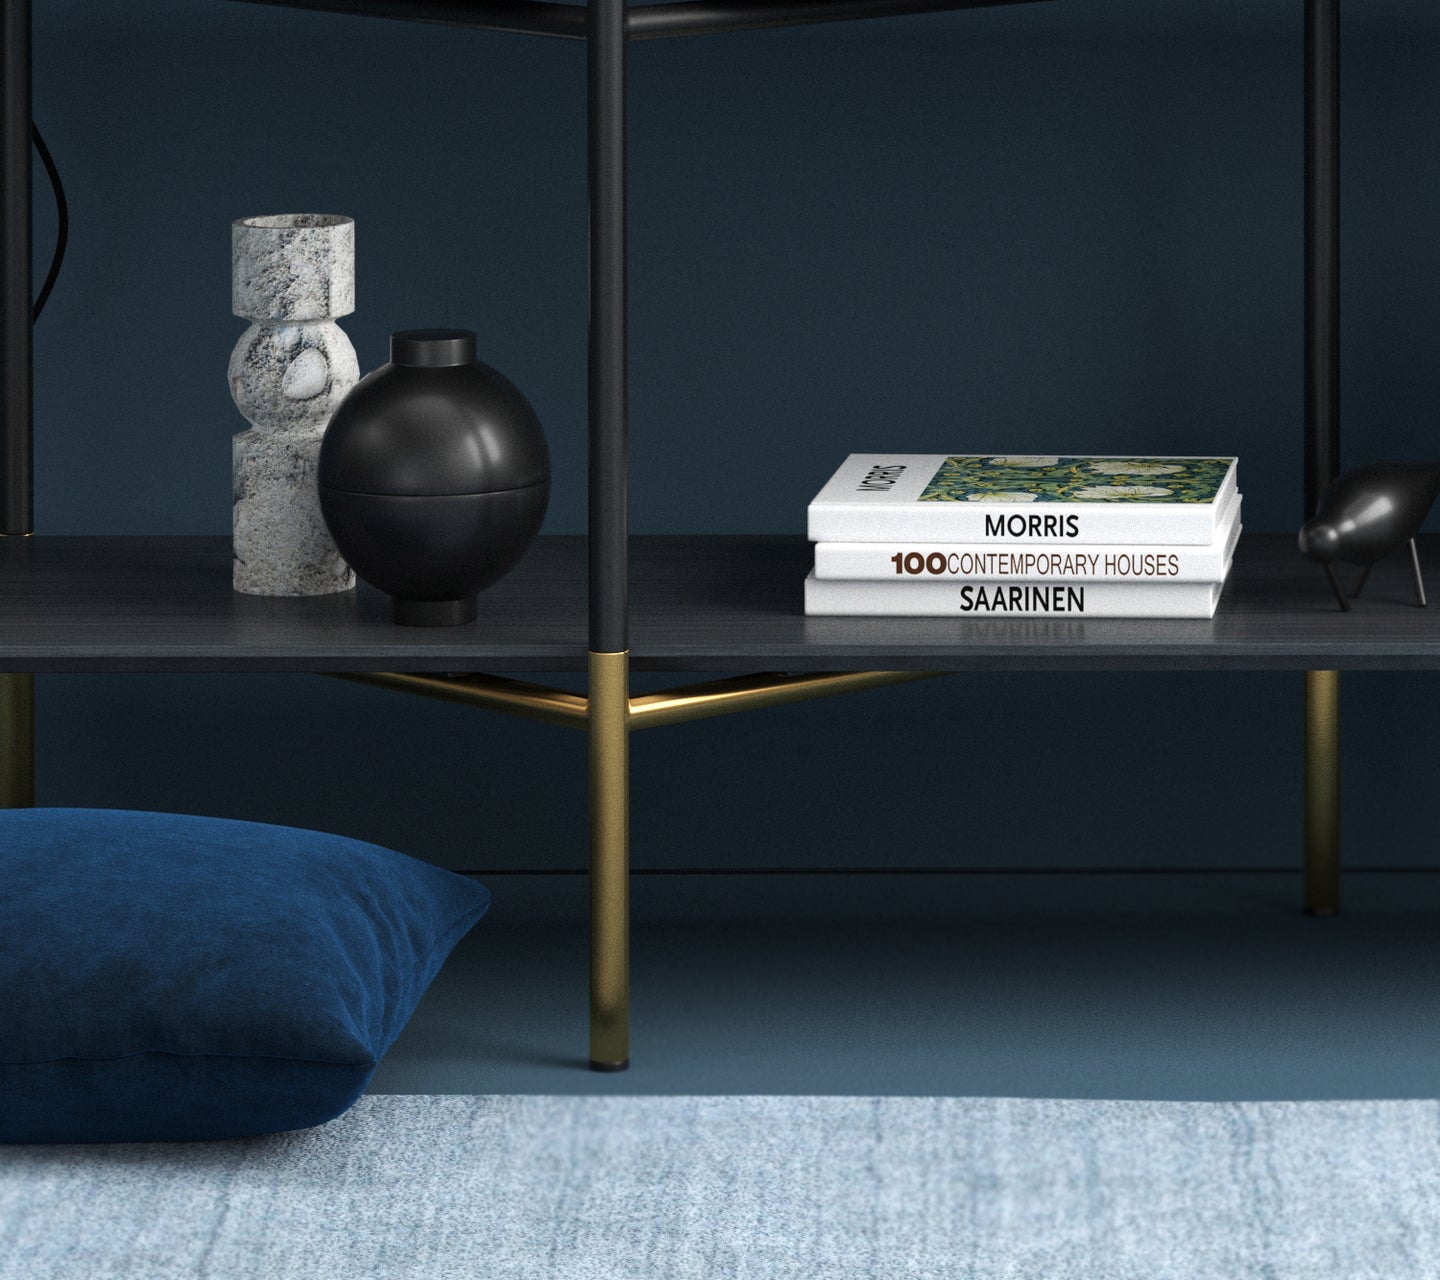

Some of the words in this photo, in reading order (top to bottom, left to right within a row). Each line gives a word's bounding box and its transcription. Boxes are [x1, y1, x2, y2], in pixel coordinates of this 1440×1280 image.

[856, 465, 907, 492] MORRIS
[985, 514, 1080, 538] MORRIS
[1105, 554, 1179, 576] HOUSES
[959, 585, 1085, 612] SAARINEN
